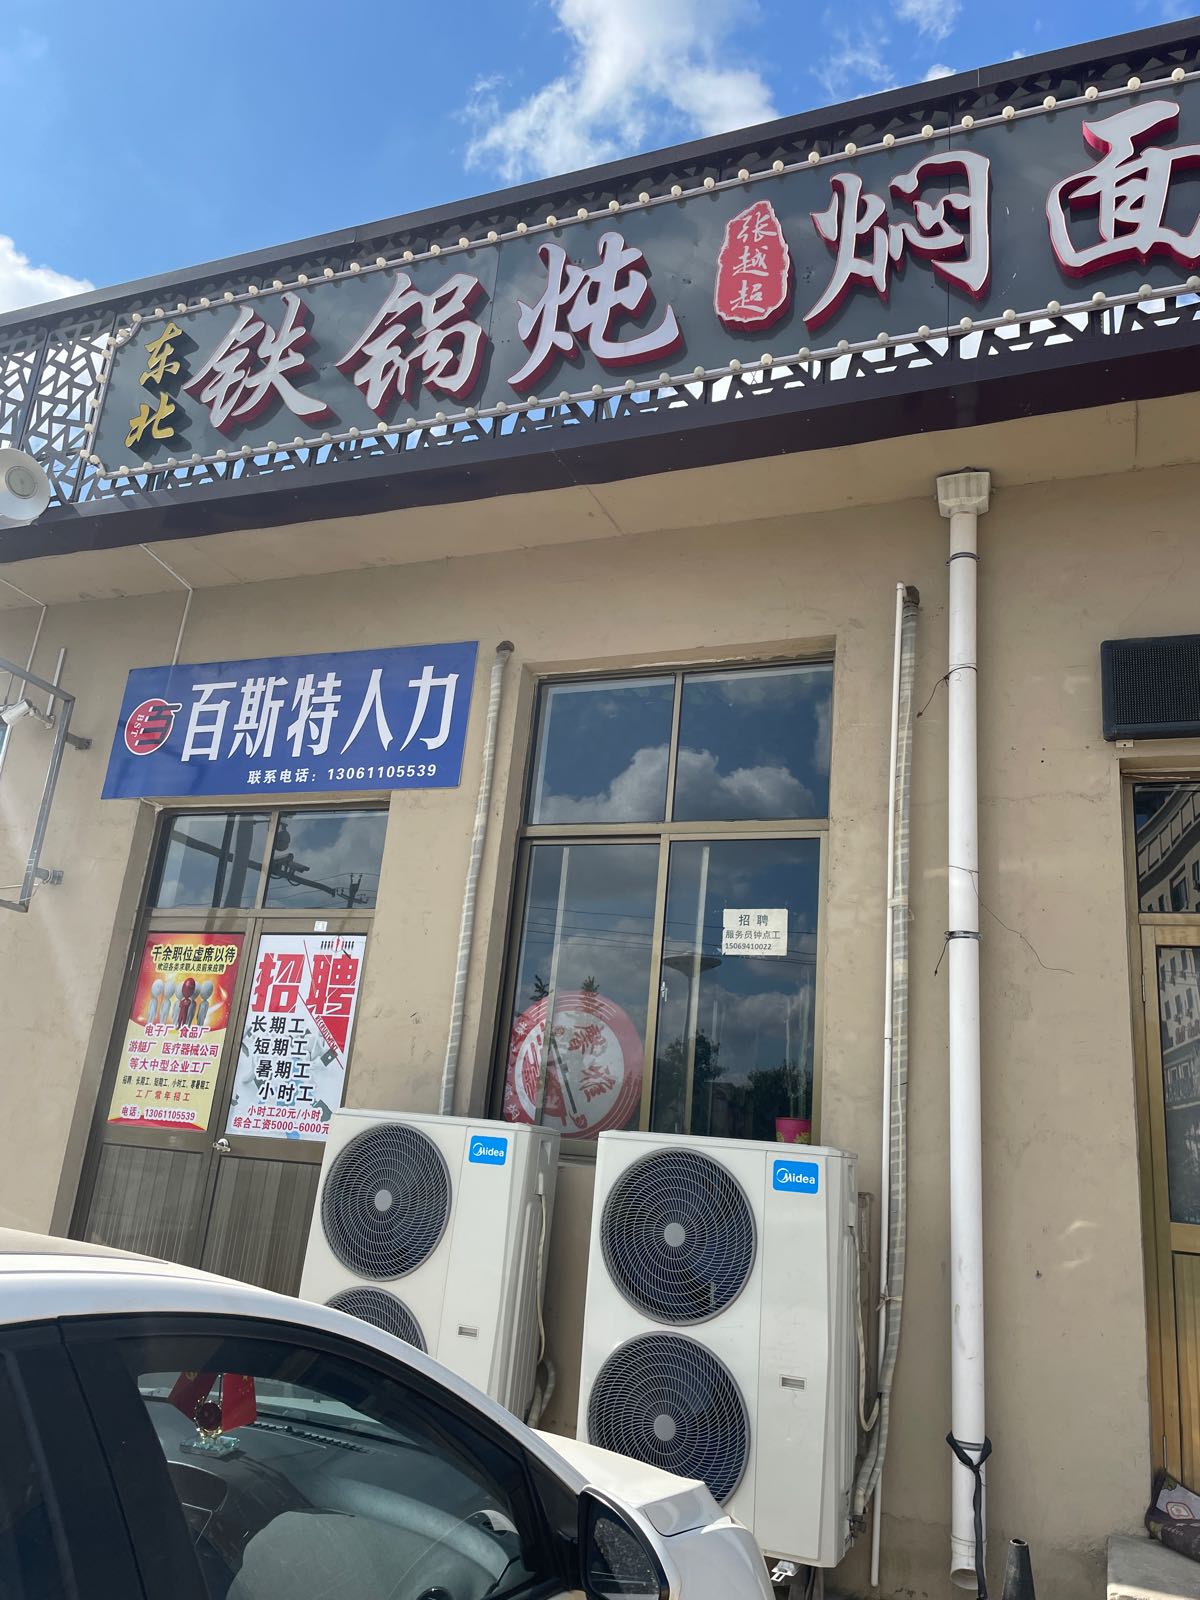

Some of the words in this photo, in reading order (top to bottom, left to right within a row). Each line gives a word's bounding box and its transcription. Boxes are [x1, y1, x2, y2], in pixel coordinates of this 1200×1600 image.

[803, 101, 1200, 328] 焖面
[730, 211, 778, 314] 张越超
[183, 232, 682, 438] 铁锅炖
[124, 322, 183, 448] 东北
[181, 665, 460, 762] 百斯特人力
[131, 714, 145, 737] BST
[725, 929, 781, 940] 服务员钟点工
[152, 946, 236, 963] 千余职位虚席以待
[725, 943, 772, 951] 15069410022
[251, 953, 360, 1015] 招聘
[145, 1024, 174, 1037] 电子厂
[180, 1026, 210, 1039] 食品厂
[251, 1015, 305, 1034] 长期工
[315, 1014, 339, 1051] RECRUITMENT
[162, 1042, 219, 1058] 医疗器械公司
[253, 1037, 308, 1056] 短期工
[130, 1057, 212, 1074] 等大中型企业工厂
[256, 1059, 310, 1079] 暑期工
[136, 1089, 191, 1102] 工厂常年招工
[258, 1082, 314, 1102] 小时工
[247, 1105, 321, 1120] 小时工20元/小时
[473, 1142, 505, 1158] Midea
[776, 1167, 816, 1186] Midea
